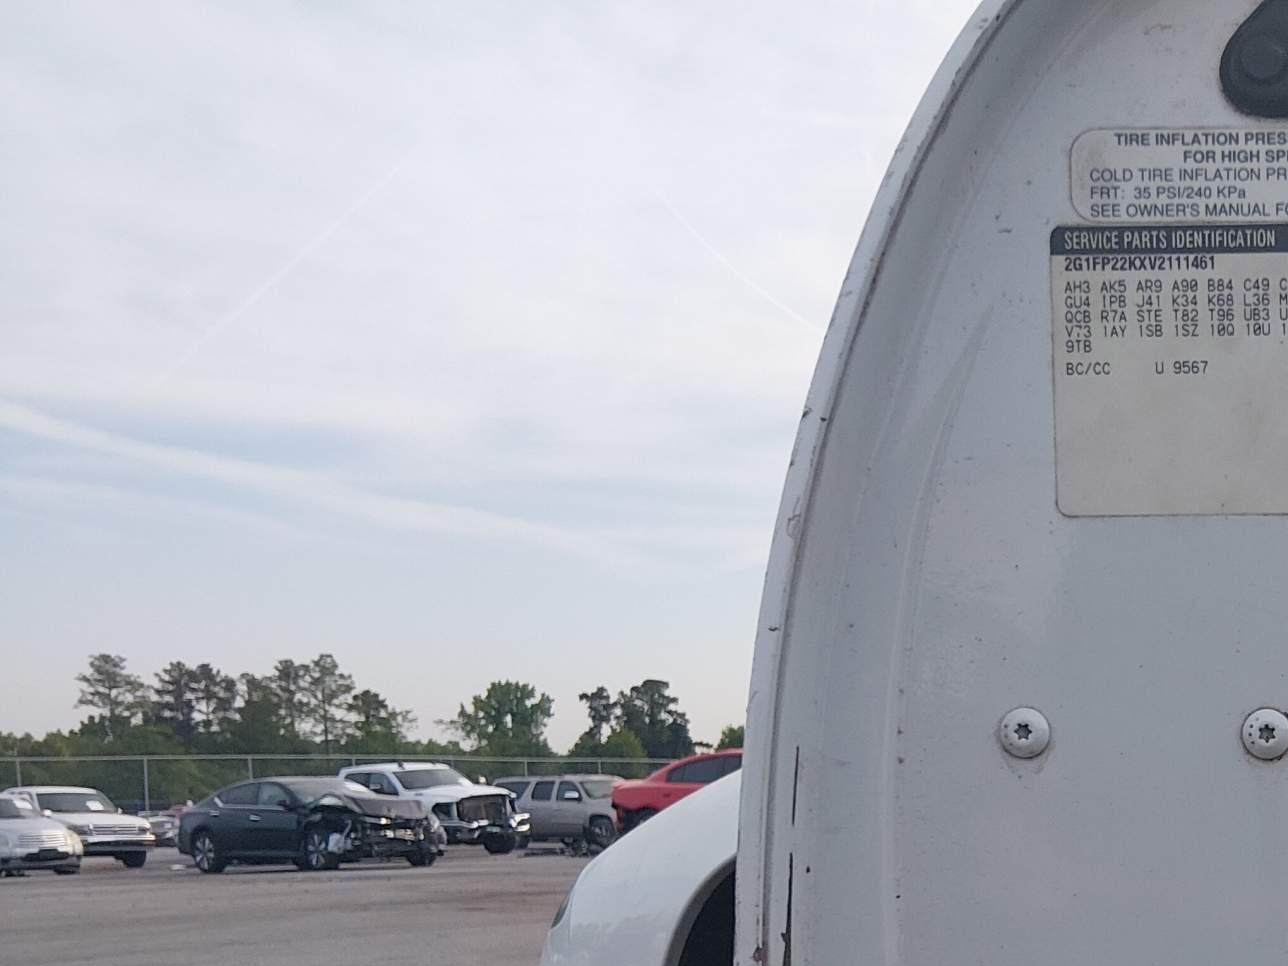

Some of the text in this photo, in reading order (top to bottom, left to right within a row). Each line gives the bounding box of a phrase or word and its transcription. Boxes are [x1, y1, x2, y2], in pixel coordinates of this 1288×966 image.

[1114, 133, 1150, 146] TIRE
[1155, 132, 1239, 146] INFLATION
[1183, 150, 1216, 163] FOR
[1221, 150, 1260, 163] HIGH
[1089, 167, 1133, 183] COLD
[1138, 168, 1173, 182] TIRE
[1179, 167, 1261, 182] INFLATION
[1090, 185, 1246, 200] FRT: 35 PSI/240 KPa
[1090, 203, 1120, 218] SEE
[1126, 203, 1200, 218] OWNER'S
[1205, 203, 1269, 217] MANUAL
[1065, 229, 1275, 249] SERVICE PARTS IDENTIFICATION
[1065, 255, 1214, 271] 2G1FP22KXV2111461
[1064, 280, 1091, 294] AH3
[1100, 280, 1127, 294] AK5
[1136, 279, 1162, 293] AR9
[1207, 278, 1233, 292] B84
[1243, 278, 1270, 292] C49
[1065, 339, 1092, 353] 9TB
[1066, 362, 1110, 376] BC/CC
[1155, 361, 1164, 375] U
[1173, 360, 1208, 375] 9567
